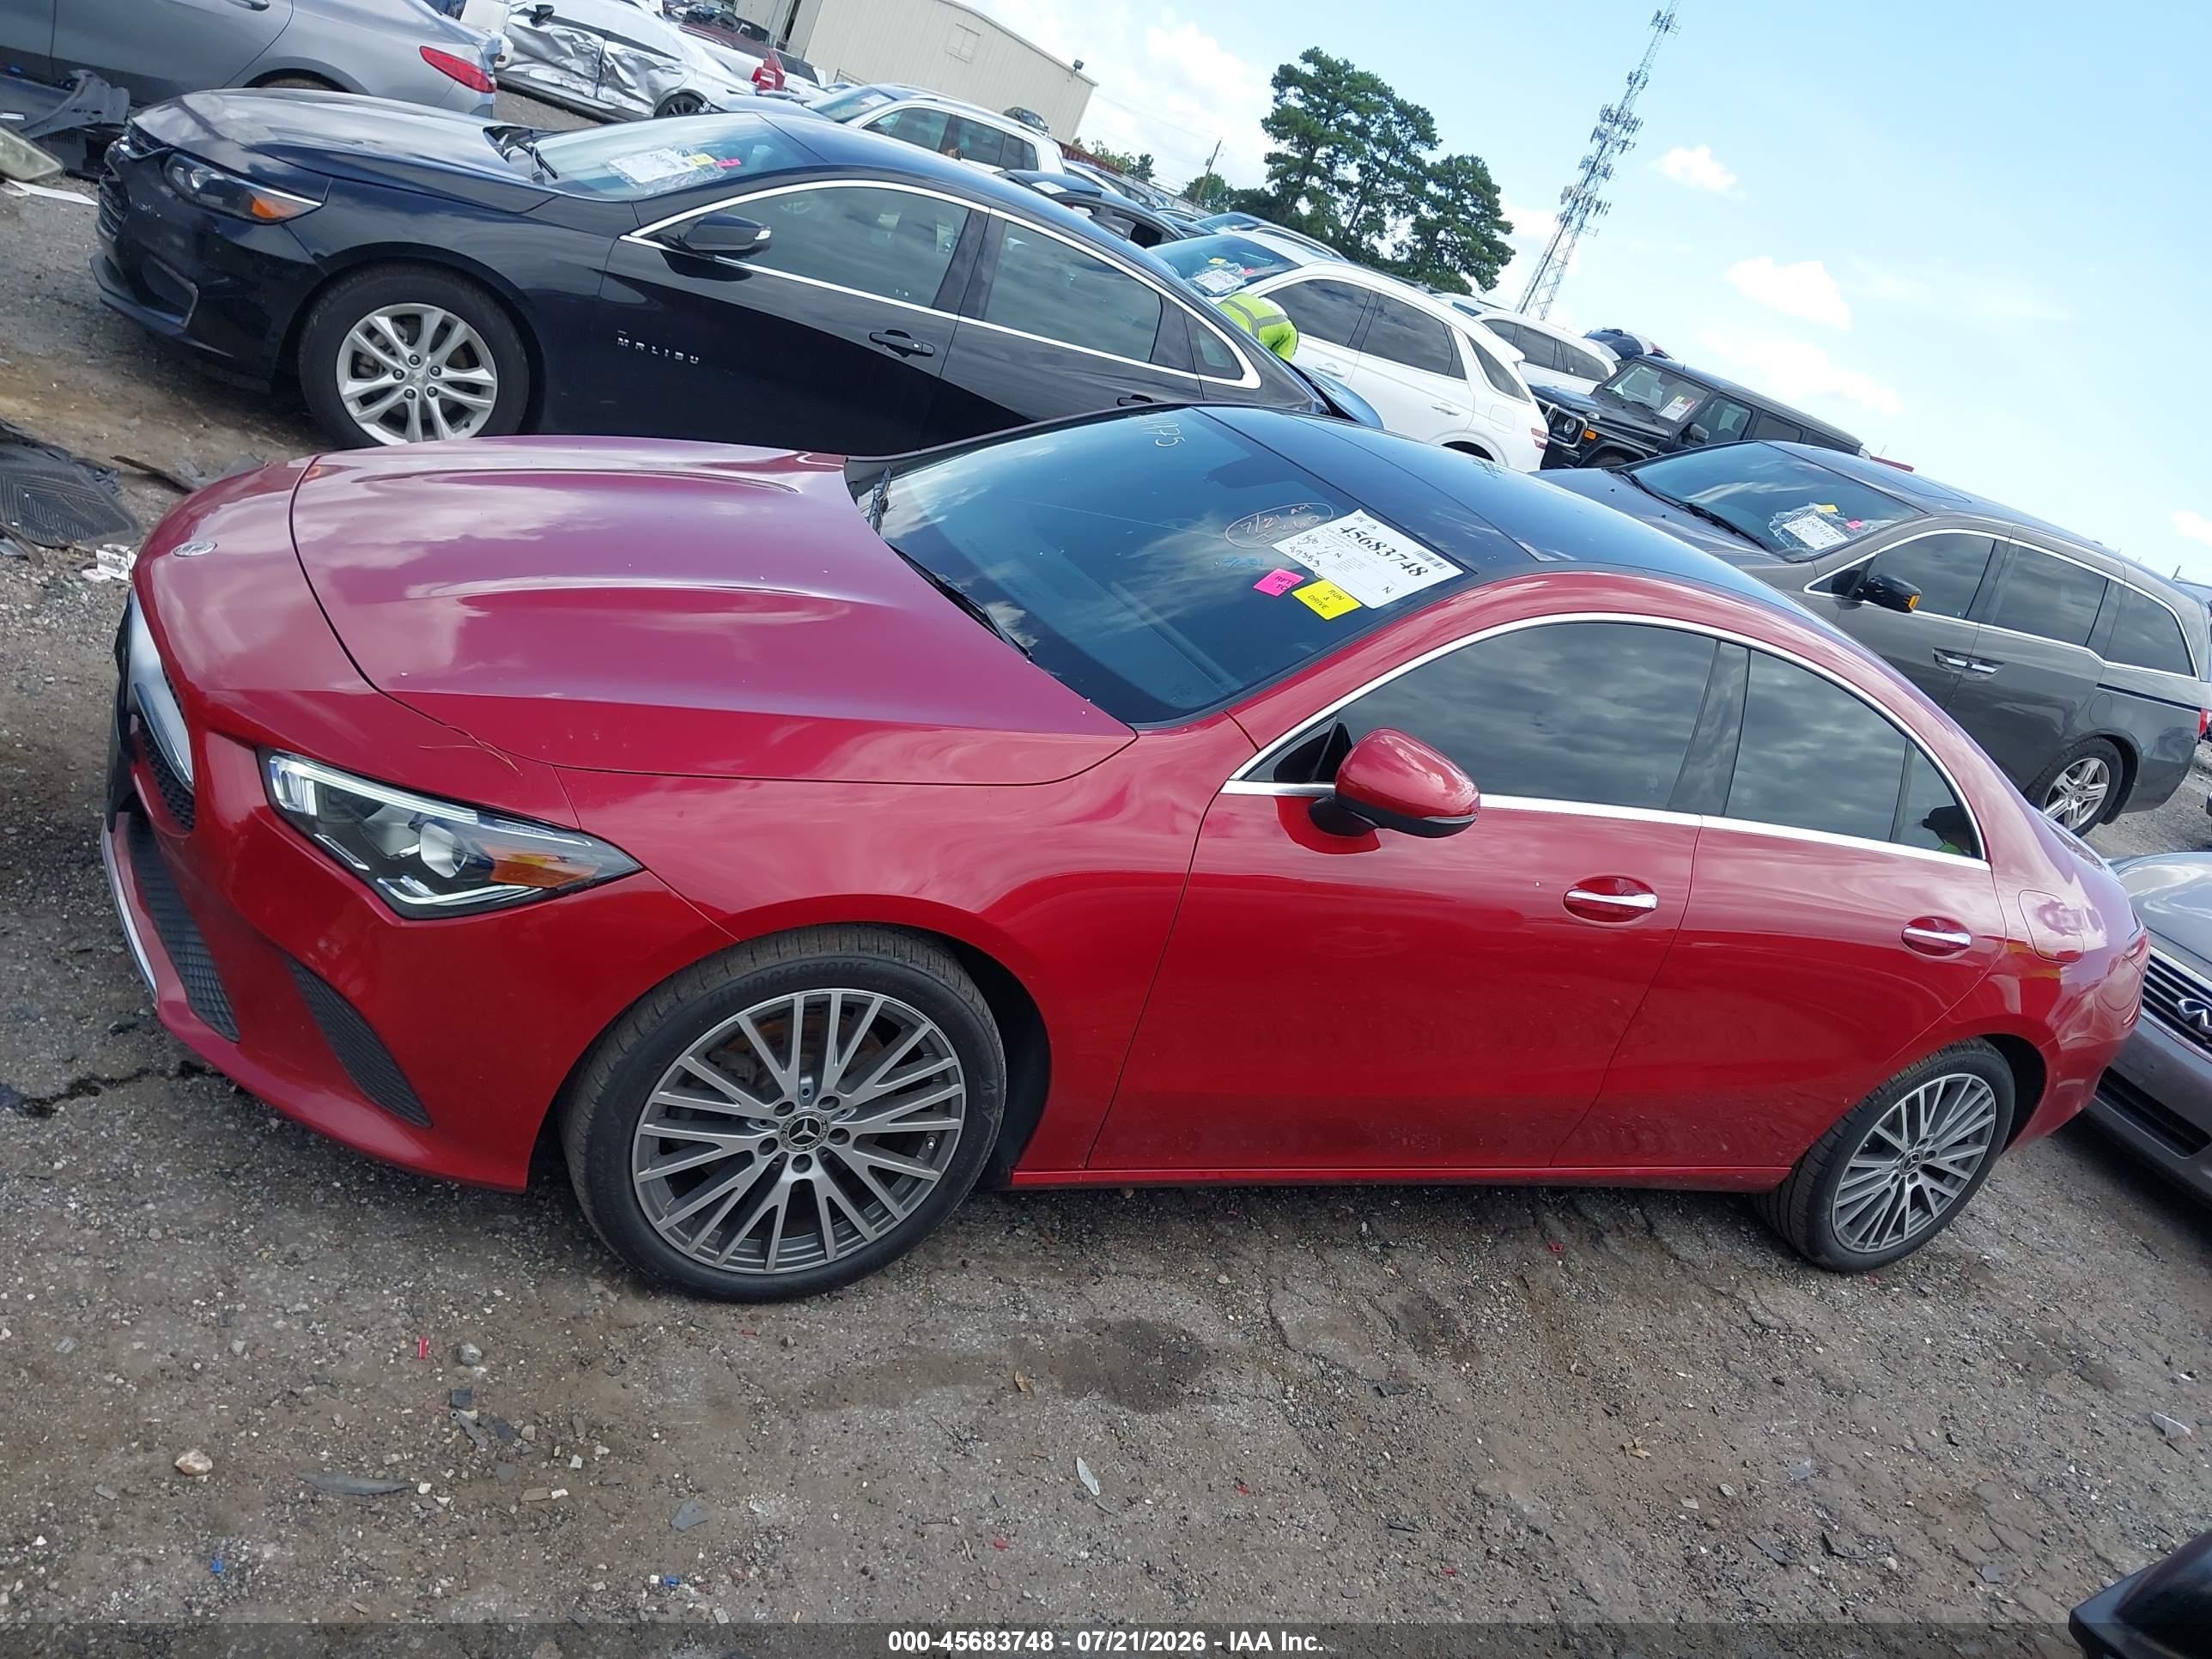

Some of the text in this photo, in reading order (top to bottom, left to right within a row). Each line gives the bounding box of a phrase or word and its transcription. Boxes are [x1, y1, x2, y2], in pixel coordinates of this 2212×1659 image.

[617, 337, 699, 365] MALIBU
[1340, 526, 1429, 577] 45683748
[1308, 594, 1330, 611] DRIVE
[1328, 589, 1346, 601] RUN
